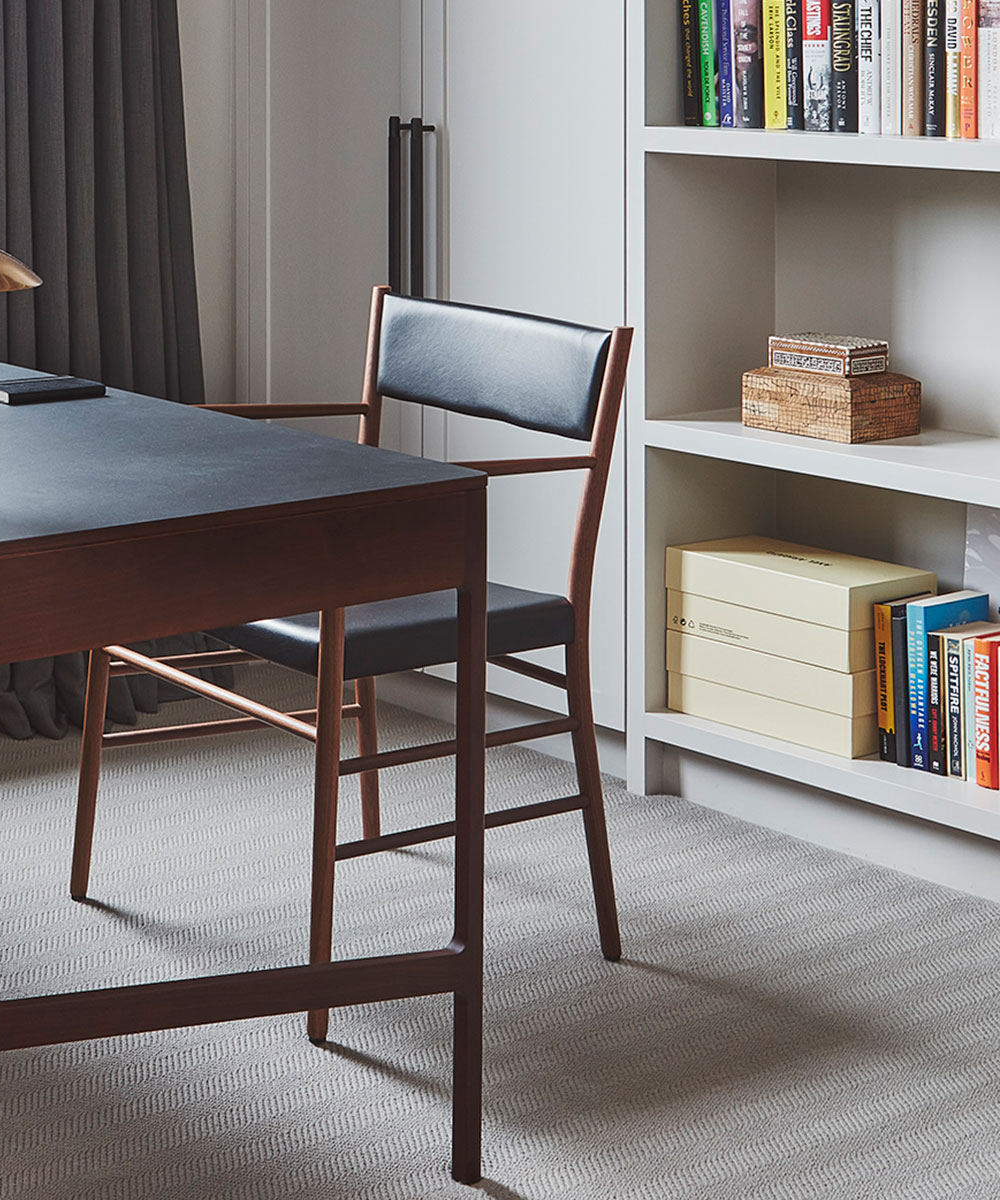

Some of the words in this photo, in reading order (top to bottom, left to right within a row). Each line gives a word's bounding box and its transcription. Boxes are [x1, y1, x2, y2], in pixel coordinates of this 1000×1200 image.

[700, 2, 709, 55] CAVENDISH
[721, 9, 729, 42] Professional
[786, 16, 797, 49] Class
[860, 6, 872, 29] THE
[684, 28, 692, 41] that
[832, 2, 852, 72] STALINGRAD
[861, 30, 873, 63] CHIEF
[947, 18, 957, 50] DAVID
[684, 42, 692, 68] changed
[915, 619, 923, 635] THE
[878, 641, 887, 656] THE
[908, 630, 916, 668] PATRICK
[916, 640, 924, 675] OXYGEN
[929, 650, 938, 660] WE
[878, 655, 888, 693] LOCKHART
[930, 660, 938, 676] WERE
[930, 676, 939, 705] WARRIORS
[949, 655, 960, 714] SPITFIRE
[879, 694, 888, 712] PLOT
[917, 678, 925, 729] ADVANTAGE
[975, 653, 991, 753] FACTFULNESS
[951, 715, 959, 733] JOHN
[952, 734, 960, 757] NICHOL
